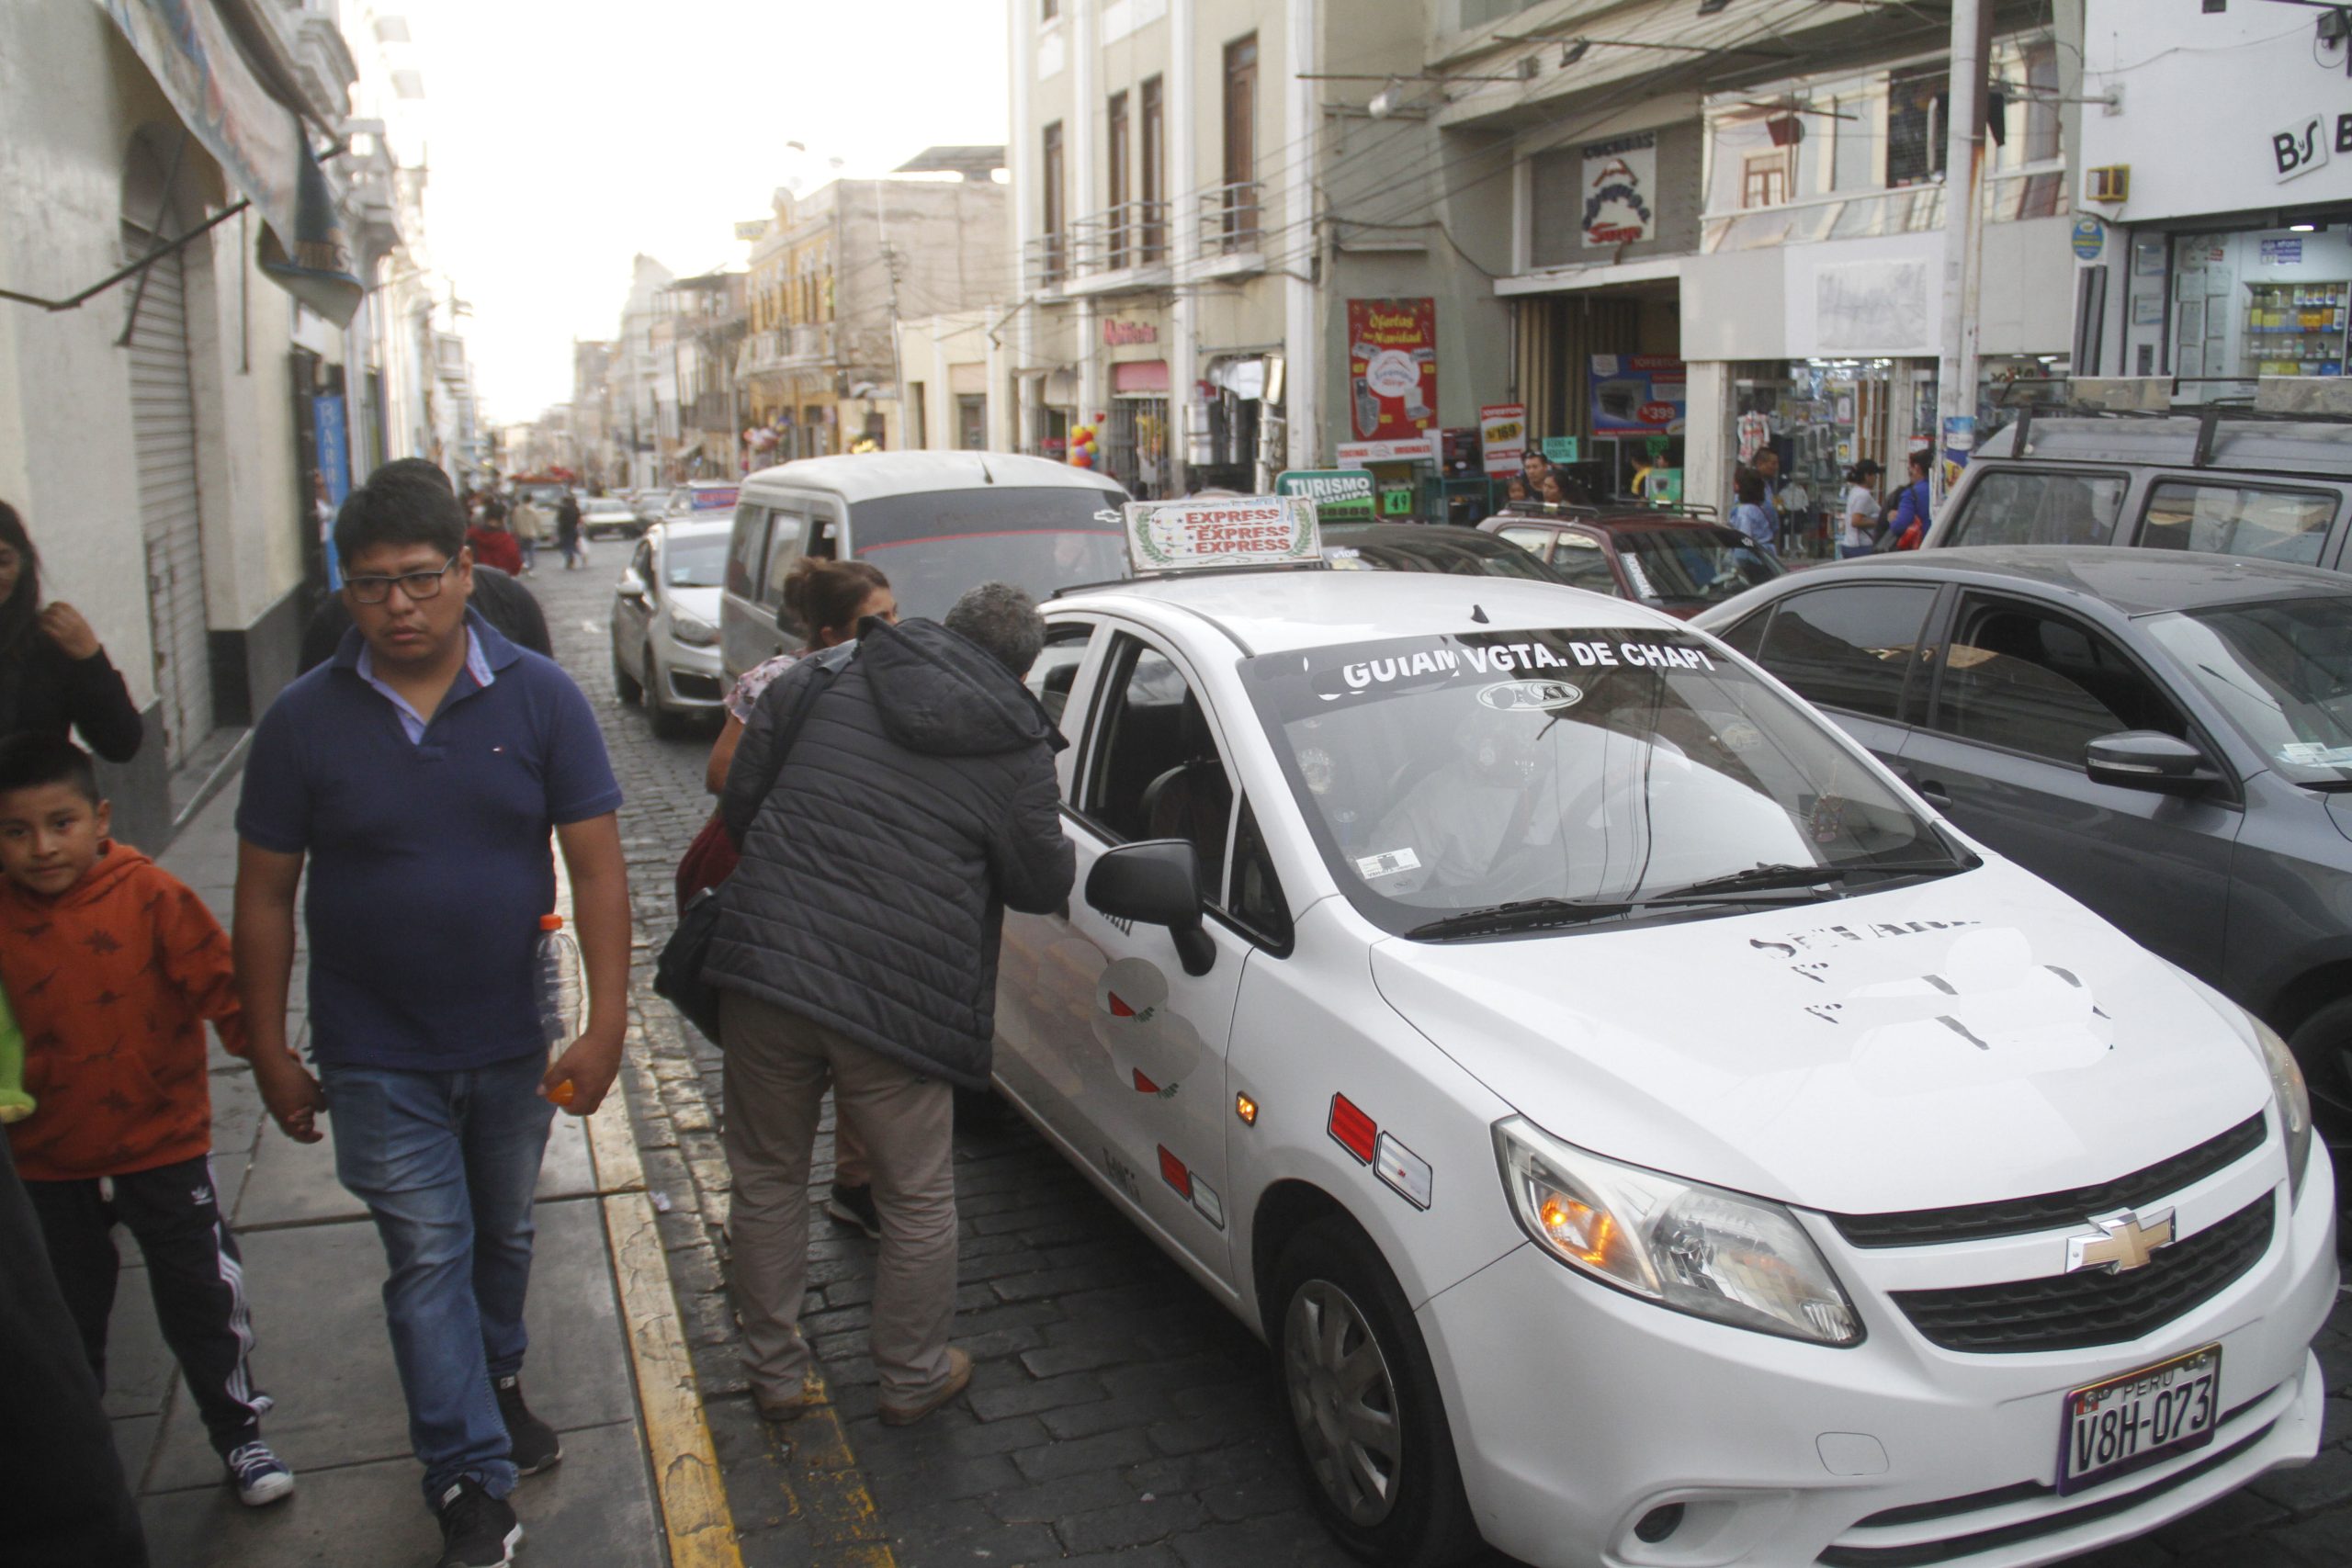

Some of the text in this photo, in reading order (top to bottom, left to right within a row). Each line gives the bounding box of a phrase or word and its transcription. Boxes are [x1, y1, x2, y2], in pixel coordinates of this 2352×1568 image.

[1287, 477, 1370, 501] TURISMO
[1185, 508, 1280, 525] EXPRESS
[1196, 525, 1291, 542] EXPRESS
[1195, 538, 1291, 554] EXPRESS
[1462, 643, 1568, 674] VGTA.
[1569, 641, 1619, 666] DE
[1620, 643, 1715, 671] CHAPI
[2077, 1373, 2212, 1472] V8H-073
